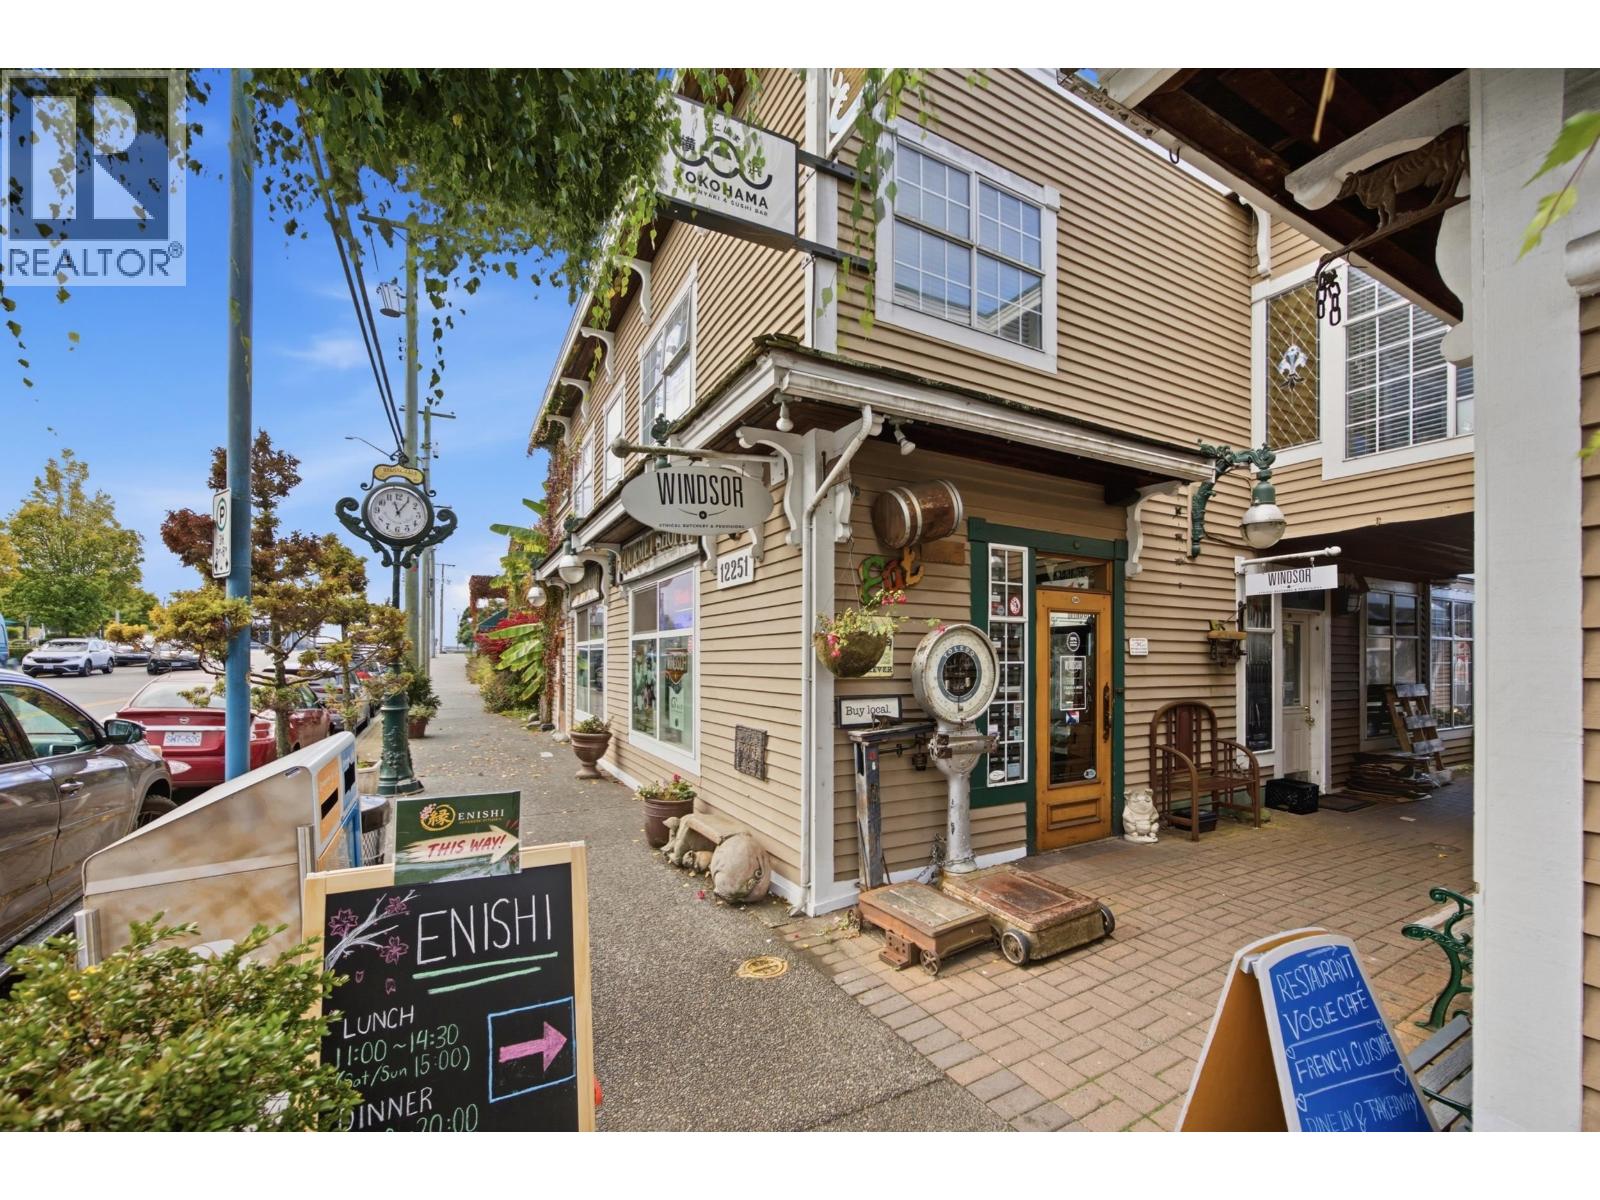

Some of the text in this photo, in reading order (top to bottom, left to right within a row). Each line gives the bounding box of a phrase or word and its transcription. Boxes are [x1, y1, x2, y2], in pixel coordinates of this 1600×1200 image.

[685, 171, 769, 210] OKOHAMA
[730, 200, 752, 211] SUSHI
[754, 207, 769, 217] BAR
[656, 472, 744, 508] WINDSOR
[720, 555, 748, 583] 12251
[1267, 568, 1312, 587] WINDSOR
[845, 706, 866, 717] Buy
[458, 809, 505, 821] ENISHI
[428, 834, 507, 858] THIS WAY!
[416, 893, 552, 966] ENISHI
[1276, 954, 1355, 1003] RESTAURANT
[343, 1004, 414, 1039] LUNCH
[1282, 1001, 1339, 1041] VOGUE
[415, 1045, 471, 1078] 15:00)
[1294, 1047, 1352, 1084] FRENCH
[1305, 1113, 1340, 1132] DINE
[1353, 1102, 1367, 1132] &
